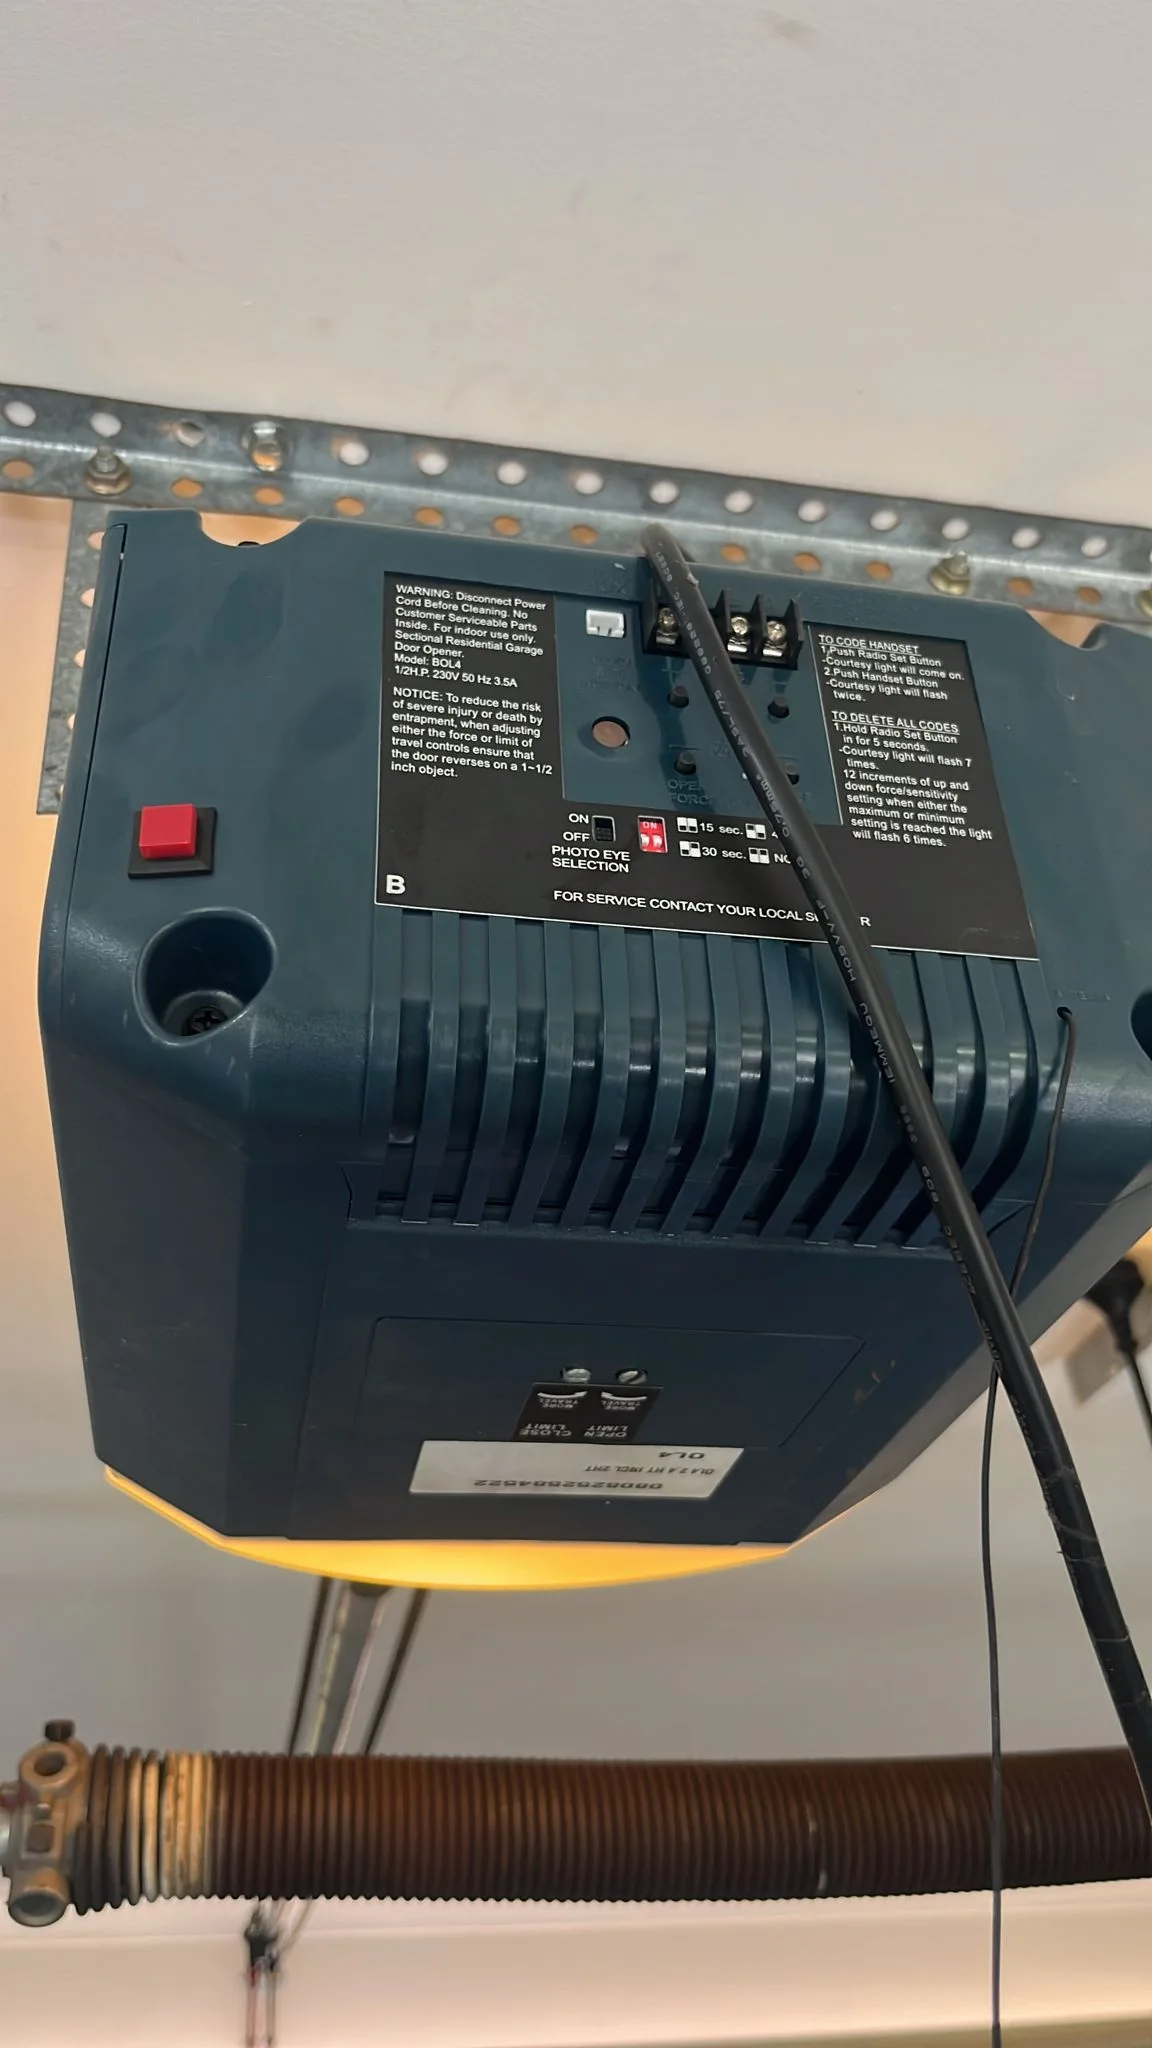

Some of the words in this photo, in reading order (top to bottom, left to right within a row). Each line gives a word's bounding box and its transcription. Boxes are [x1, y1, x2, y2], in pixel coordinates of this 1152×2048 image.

[396, 584, 453, 599] WARNING:
[456, 591, 511, 606] Disconnect
[514, 598, 546, 609] Power
[395, 595, 421, 606] Cord
[424, 598, 458, 611] Before
[461, 603, 509, 618] Cleaning.
[513, 609, 528, 619] No
[395, 607, 446, 620] Customer
[448, 613, 508, 628] Serviceable
[510, 620, 537, 631] Parts
[395, 618, 430, 630] Inside.
[433, 623, 452, 632] For
[454, 625, 487, 637] indoor
[490, 631, 509, 639] use
[511, 633, 535, 644] only.
[394, 641, 420, 652] Door
[423, 644, 464, 659] Opener.
[395, 630, 443, 643] Sectional
[445, 635, 502, 650] Residential
[505, 642, 543, 656] Garage
[819, 634, 834, 644] TO
[836, 637, 867, 648] CODE
[869, 640, 919, 654] HANDSET
[394, 653, 428, 665] Model:
[432, 657, 461, 669] BOL4
[857, 649, 887, 660] Radio
[889, 653, 907, 663] Set
[909, 655, 941, 666] Button
[395, 665, 430, 677] 1/2H.P.
[432, 669, 459, 680] 230V
[462, 672, 475, 682] 50
[477, 674, 491, 684] Hz
[494, 676, 517, 687] 3.5A
[824, 666, 859, 678] 2.Push
[861, 671, 903, 684] Handset
[906, 676, 938, 688] Button
[874, 662, 897, 673] light
[899, 666, 916, 674] will
[919, 669, 946, 678] come
[948, 672, 964, 680] on.
[393, 686, 442, 701] NOTICE:
[445, 692, 459, 702] To
[461, 696, 499, 707] reduce
[501, 700, 519, 709] the
[522, 702, 541, 712] risk
[833, 690, 865, 701] twice.
[878, 684, 901, 695] light
[903, 688, 920, 696] will
[922, 689, 947, 699] flash
[393, 700, 404, 708] of
[406, 703, 444, 713] severe
[447, 705, 478, 719] injury
[481, 710, 492, 718] or
[495, 711, 526, 722] death
[529, 714, 543, 726] by
[831, 710, 847, 721] TO
[850, 712, 894, 726] DELETE
[897, 717, 915, 729] ALL
[919, 720, 959, 733] CODES
[392, 713, 457, 730] entrapment,
[460, 720, 489, 730] when
[492, 723, 540, 738] adjusting
[834, 723, 867, 733] 1.Hold
[870, 727, 900, 737] Radio
[903, 730, 921, 739] Set
[923, 732, 957, 743] Button
[392, 724, 425, 735] either
[428, 728, 445, 738] the
[449, 729, 477, 741] force
[495, 735, 518, 746] limit
[521, 738, 532, 747] of
[843, 734, 853, 743] in
[855, 735, 870, 745] for
[873, 737, 880, 746] 5
[883, 740, 929, 751] seconds.
[391, 736, 422, 748] travel
[426, 741, 469, 753] controls
[472, 746, 510, 757] ensure
[513, 749, 534, 760] that
[391, 749, 409, 759] the
[412, 751, 438, 762] door
[441, 756, 490, 768] reverses
[493, 761, 507, 769] on
[521, 762, 552, 774] 1~1/2
[846, 758, 879, 769] times.
[892, 750, 915, 762] light
[917, 754, 934, 763] will
[937, 755, 962, 766] flash
[965, 758, 971, 767] 7
[391, 761, 415, 772] inch
[418, 765, 457, 777] object.
[843, 769, 856, 779] 12
[859, 771, 917, 785] increments
[920, 777, 930, 786] of
[933, 780, 946, 789] up
[949, 781, 969, 790] and
[844, 781, 873, 792] down
[875, 783, 958, 802] force/sensitivity
[846, 794, 883, 806] setting
[885, 797, 914, 807] when
[917, 800, 947, 811] either
[950, 803, 967, 813] the
[568, 813, 589, 824] ON
[849, 806, 900, 818] maximum
[903, 811, 914, 819] or
[917, 812, 965, 824] minimum
[643, 821, 658, 829] ON
[700, 822, 714, 833] 15
[719, 825, 744, 835] sec.
[851, 818, 887, 831] setting
[890, 820, 900, 830] is
[903, 823, 946, 834] reached
[948, 826, 966, 836] the
[968, 828, 992, 840] light
[563, 831, 591, 843] OFF
[852, 830, 871, 839] will
[874, 831, 900, 842] flash
[903, 833, 910, 843] 6
[913, 835, 946, 846] times.
[551, 845, 600, 859] PHOTO
[603, 849, 631, 862] EYE
[702, 846, 717, 857] 30
[722, 849, 747, 859] sec.
[552, 857, 629, 873] SELECTION
[386, 874, 406, 894] B
[553, 890, 583, 903] FOR
[586, 892, 646, 908] SERVICE
[649, 898, 714, 914] CONTACT
[716, 903, 757, 917] YOUR
[759, 908, 804, 922] LOCAL
[816, 898, 857, 981] H05VV-F
[519, 1428, 572, 1437] CLOSE
[658, 1451, 705, 1460] OL4
